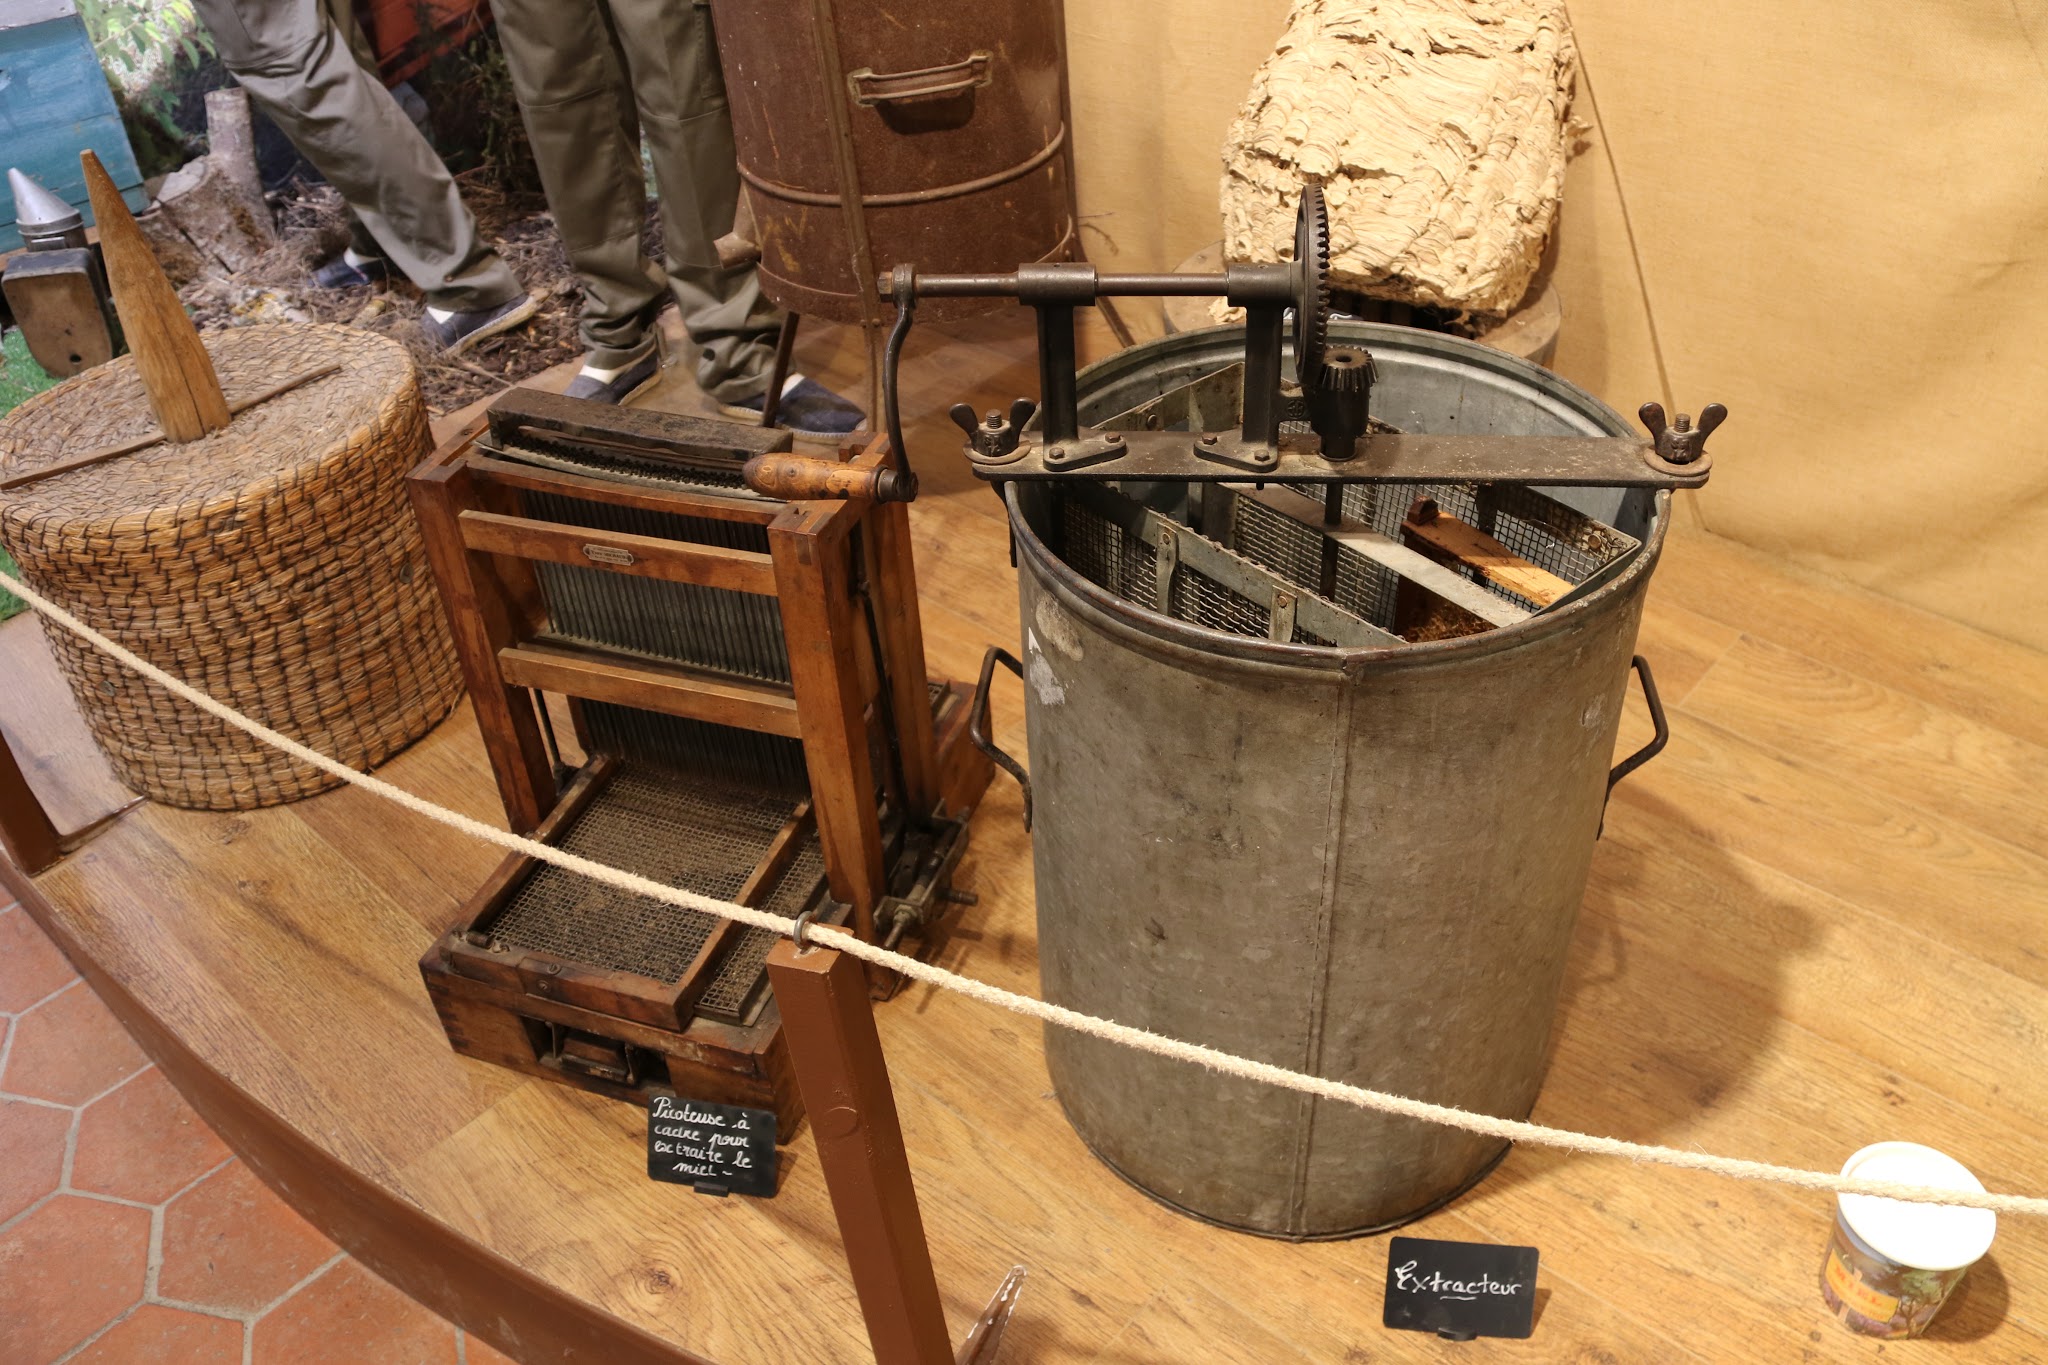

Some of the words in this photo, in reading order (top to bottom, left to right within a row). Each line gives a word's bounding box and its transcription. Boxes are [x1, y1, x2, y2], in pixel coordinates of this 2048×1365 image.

[652, 1096, 726, 1127] Picoteuse
[731, 1112, 751, 1130] à
[654, 1124, 701, 1142] cadre
[708, 1132, 750, 1153] pour
[672, 1161, 717, 1177] miel
[732, 1150, 753, 1169] le
[1394, 1259, 1522, 1295] Extracteur
